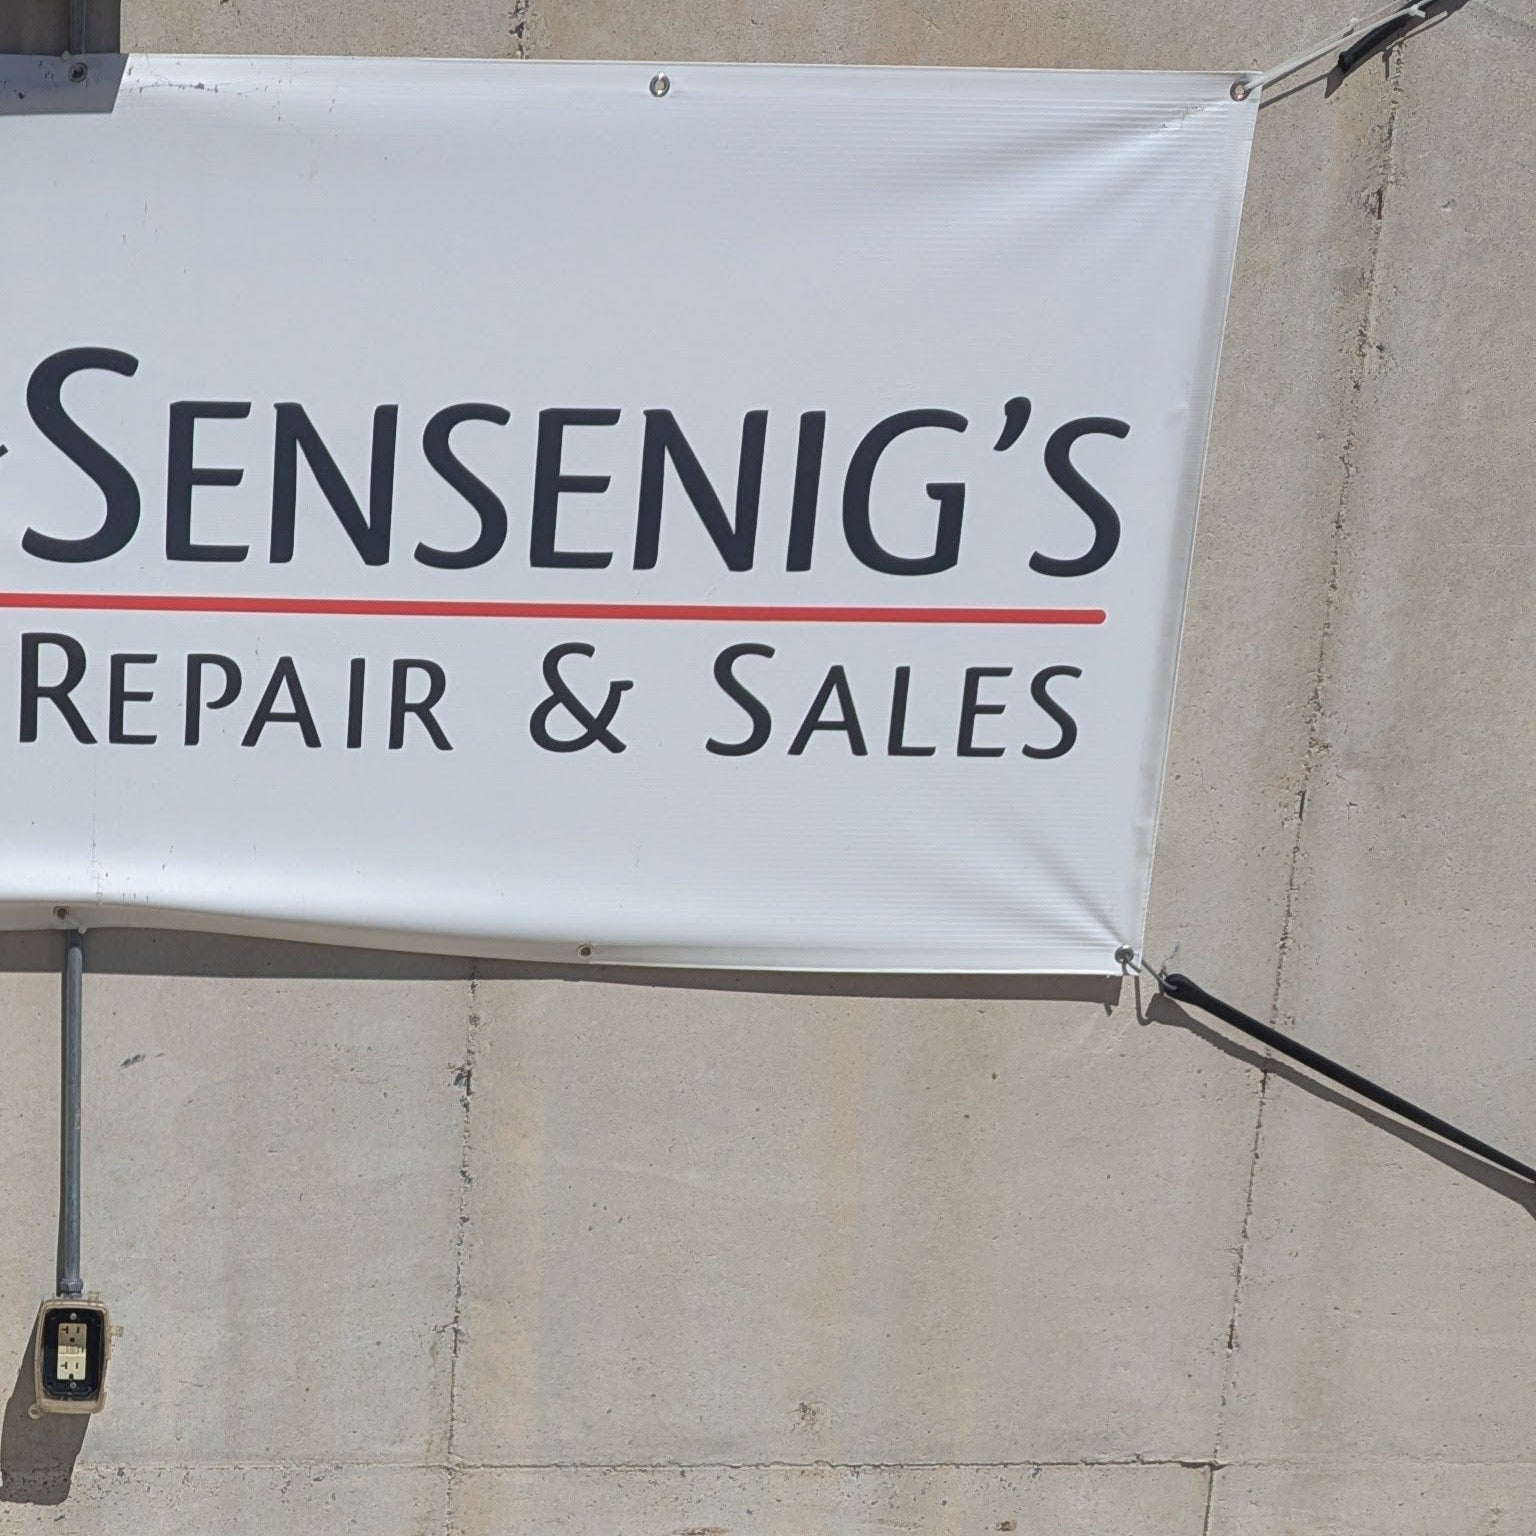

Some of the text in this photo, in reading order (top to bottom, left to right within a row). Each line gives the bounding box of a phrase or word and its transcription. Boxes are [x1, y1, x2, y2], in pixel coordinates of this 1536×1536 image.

[21, 347, 1131, 578] SENSENIG'S
[19, 632, 1083, 760] REPAIR & SALES
